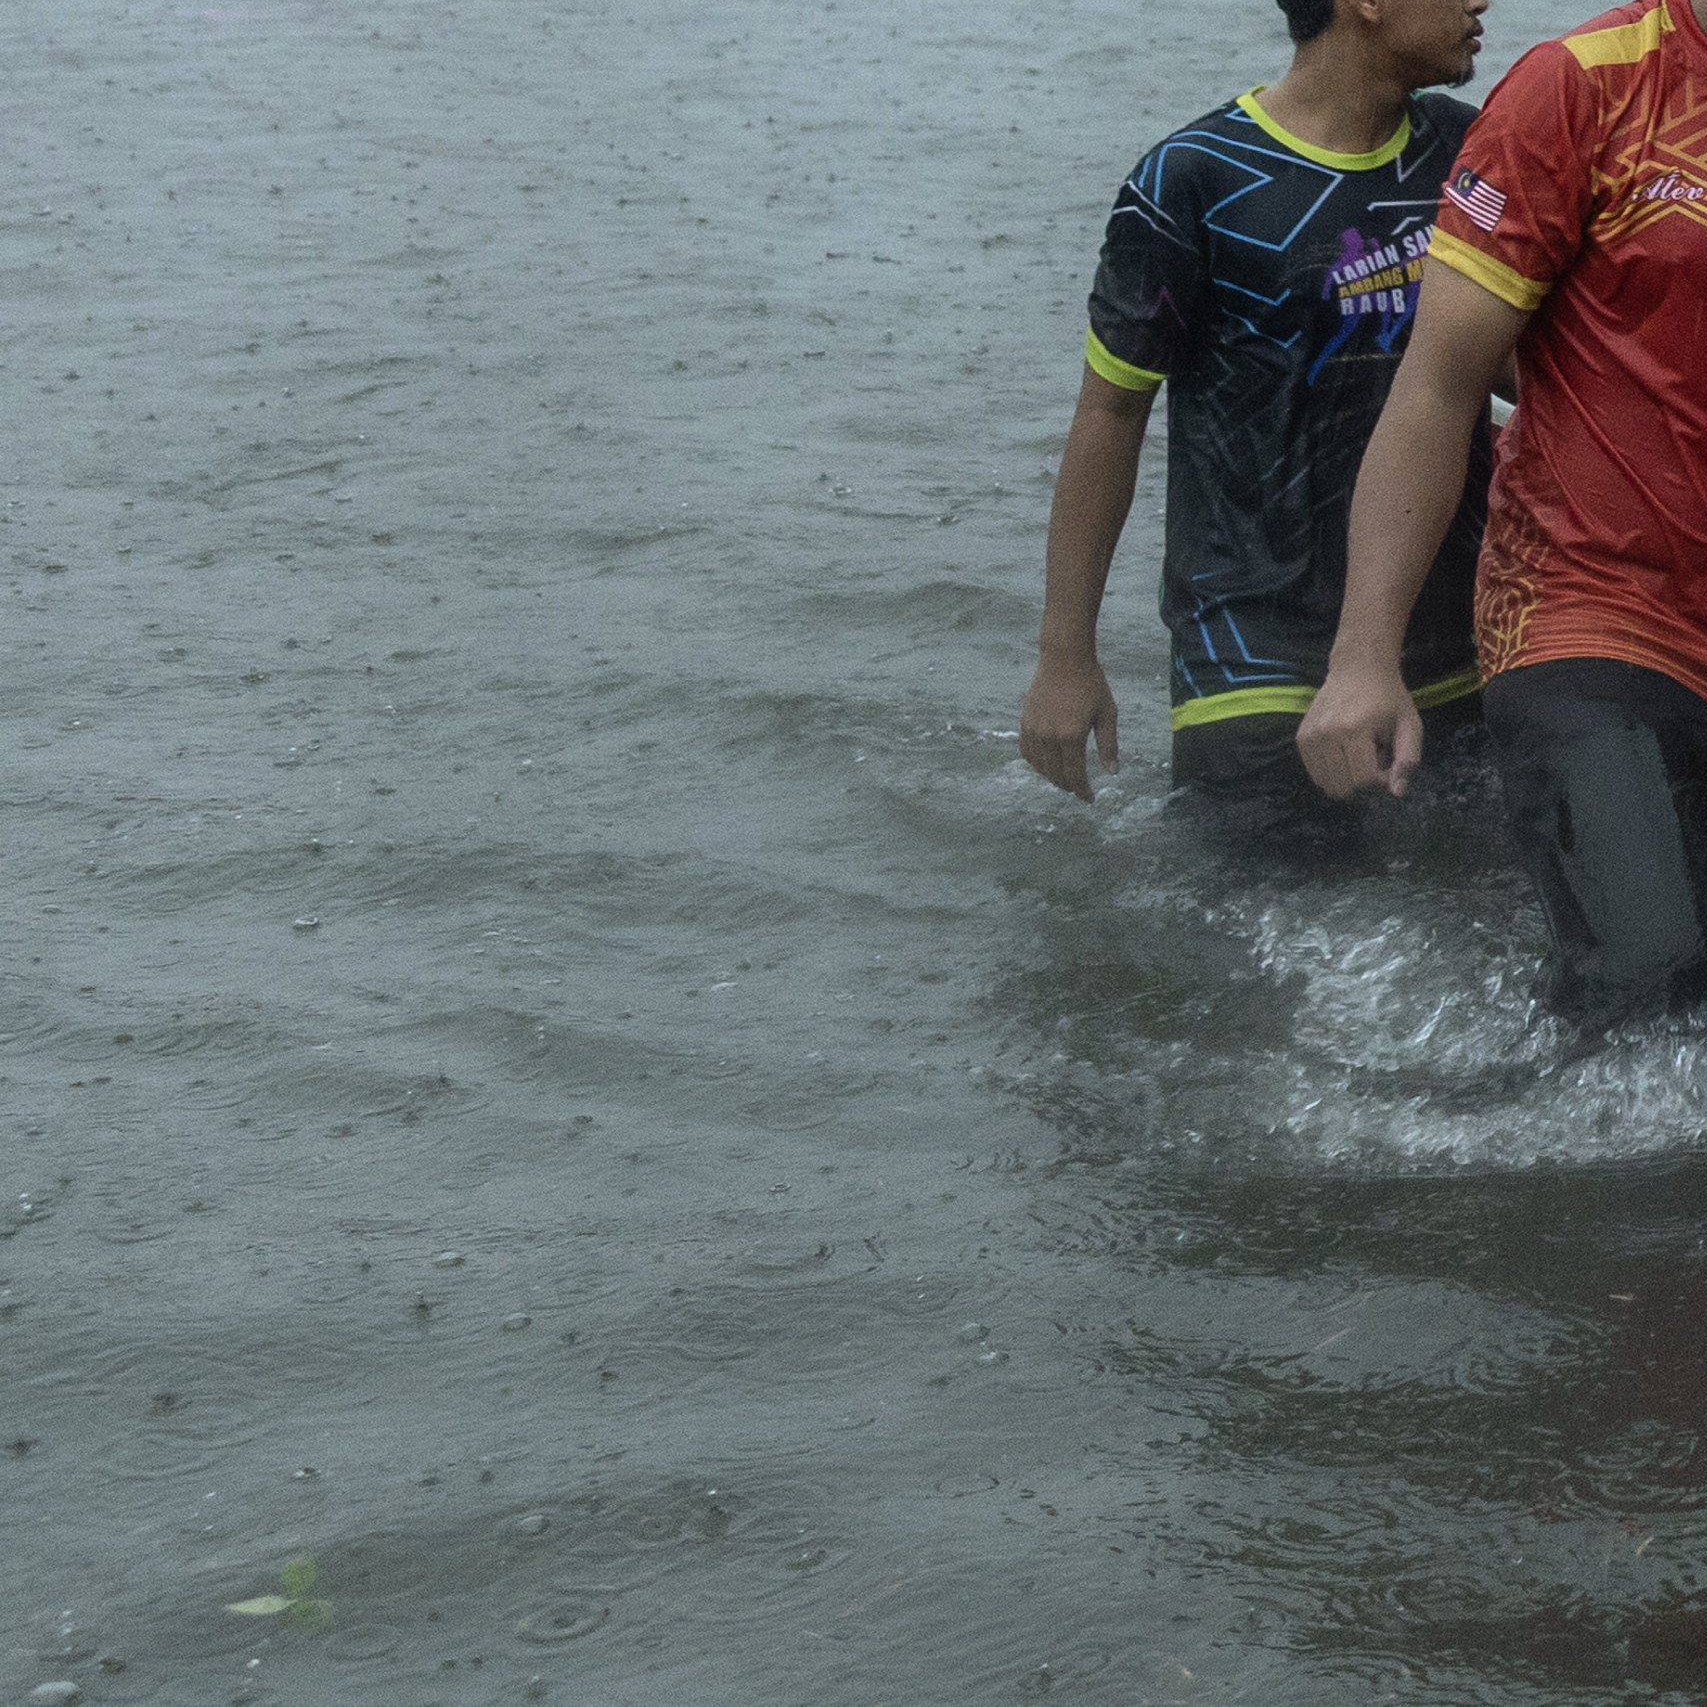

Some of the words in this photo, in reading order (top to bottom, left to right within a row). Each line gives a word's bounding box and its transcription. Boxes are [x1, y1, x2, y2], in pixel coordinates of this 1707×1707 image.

[1332, 244, 1401, 285] LARIAN
[1338, 266, 1404, 298] AMBANG
[1405, 256, 1426, 283] M
[1340, 288, 1406, 316] RAUB
